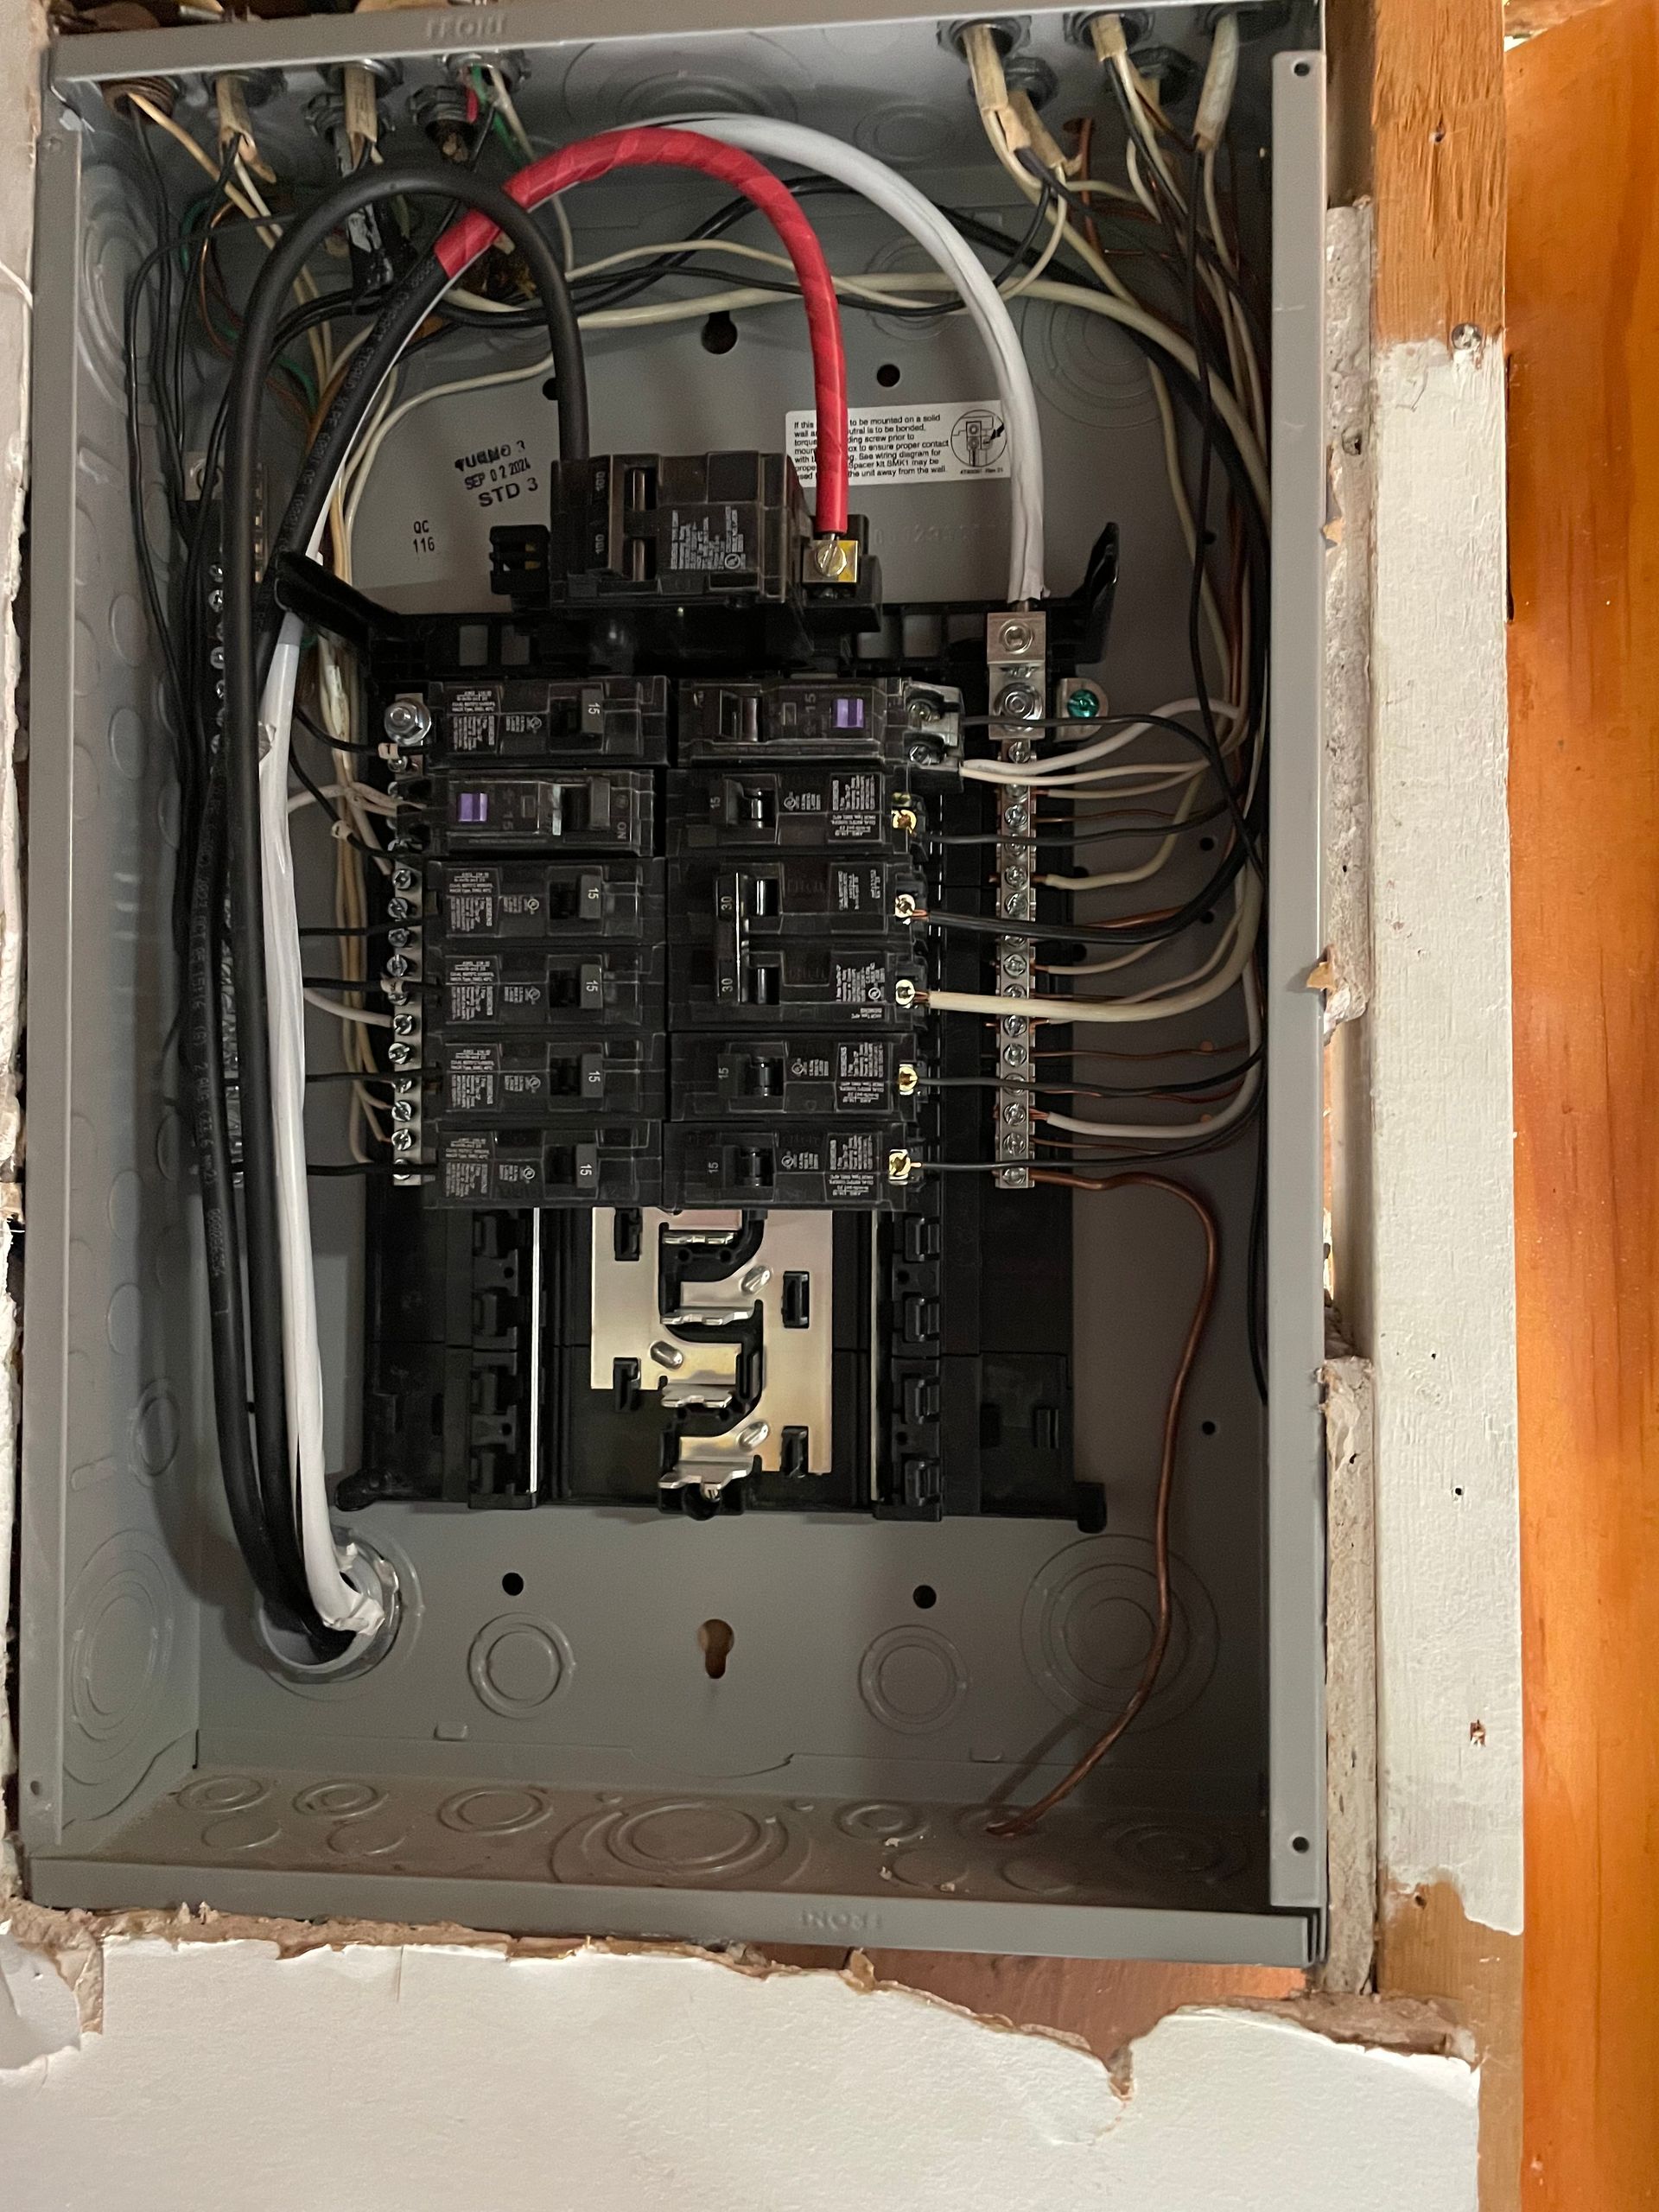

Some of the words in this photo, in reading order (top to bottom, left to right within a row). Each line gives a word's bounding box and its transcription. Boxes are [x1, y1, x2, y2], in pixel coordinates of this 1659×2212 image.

[870, 416, 903, 424] mounted
[921, 440, 949, 448] contact
[874, 452, 897, 461] wiring
[899, 450, 930, 460] diagram
[911, 458, 928, 467] may
[464, 472, 486, 490] SEP
[509, 457, 531, 476] 2024
[877, 468, 896, 477] away
[478, 482, 521, 507] STD
[527, 477, 538, 492] 3
[413, 519, 429, 534] QC
[412, 536, 435, 553] 116
[588, 702, 601, 715] 15
[805, 693, 817, 712] 15
[710, 796, 721, 809] 15
[617, 822, 626, 840] ON
[588, 888, 599, 899] 15
[721, 895, 733, 911] 30
[586, 980, 598, 992] 15
[721, 977, 734, 993] 30
[588, 1071, 601, 1083] 15
[718, 1066, 728, 1079] 15
[580, 1164, 592, 1176] 15
[708, 1161, 719, 1174] 15
